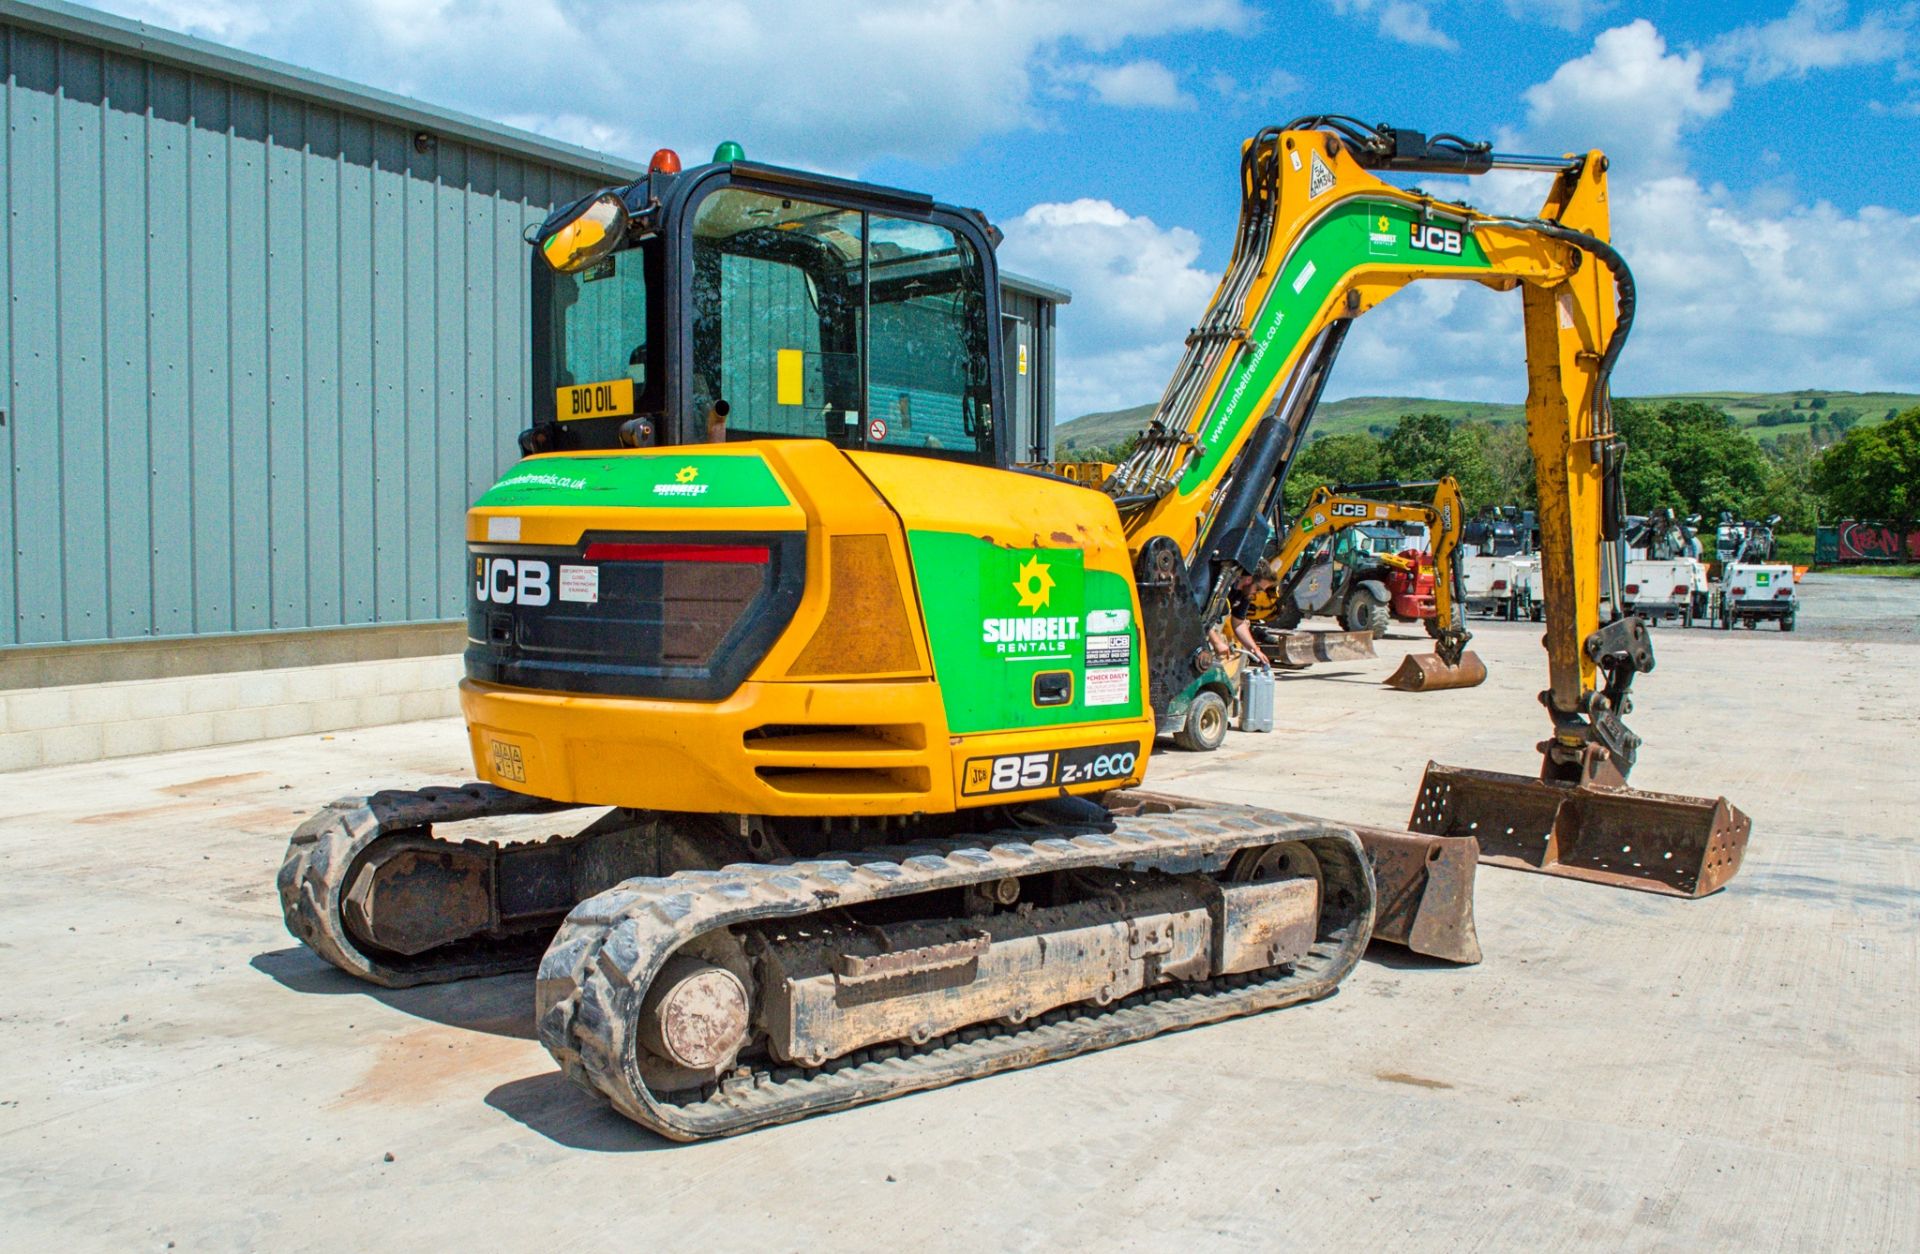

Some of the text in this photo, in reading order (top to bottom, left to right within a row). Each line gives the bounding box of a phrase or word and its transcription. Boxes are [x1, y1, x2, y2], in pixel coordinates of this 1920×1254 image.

[1370, 232, 1397, 242] SUNBELT
[1410, 224, 1462, 254] JCB
[1210, 310, 1285, 443] www.sunbeltrentals.co.uk
[595, 385, 617, 412] OIL
[652, 484, 710, 493] SUNBELT
[1331, 503, 1367, 517] JCB
[476, 557, 551, 607] JCB
[983, 616, 1079, 643] SUNBELT
[997, 642, 1066, 654] RENTALS
[972, 768, 987, 784] JCB
[991, 753, 1050, 790] 85
